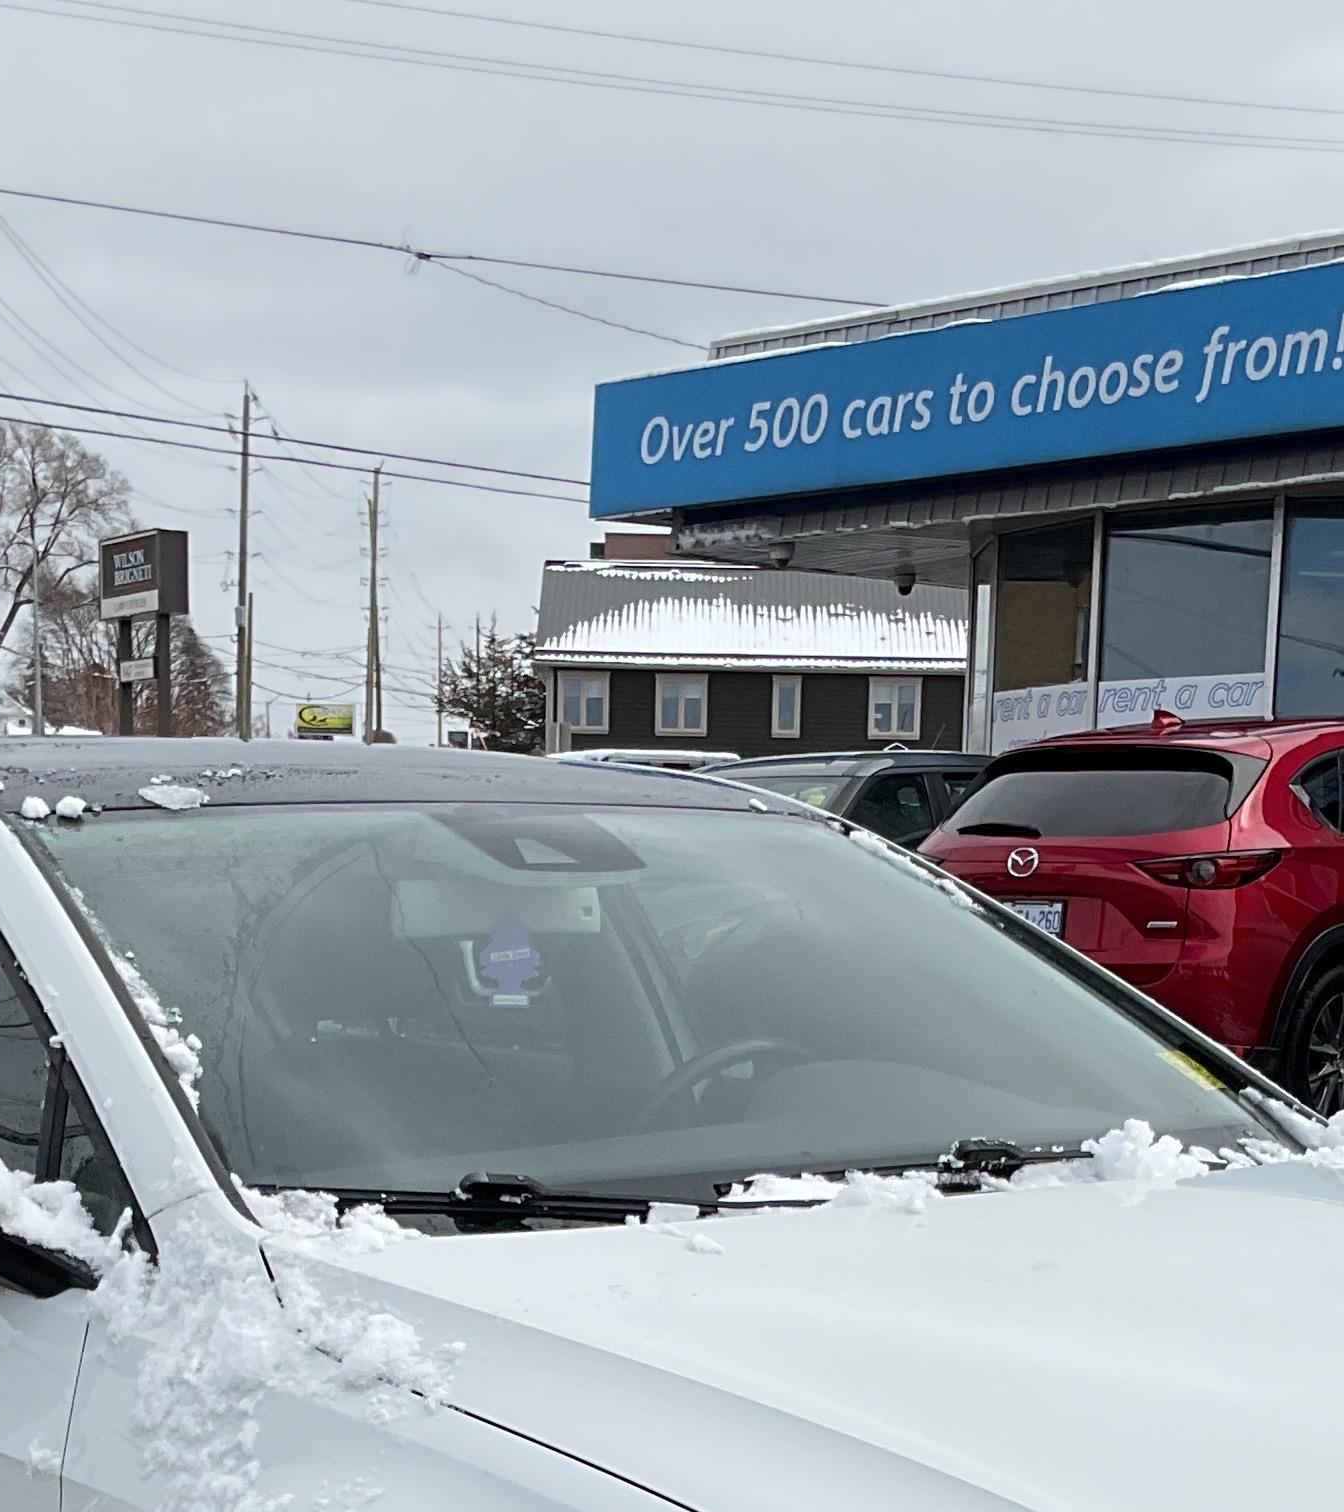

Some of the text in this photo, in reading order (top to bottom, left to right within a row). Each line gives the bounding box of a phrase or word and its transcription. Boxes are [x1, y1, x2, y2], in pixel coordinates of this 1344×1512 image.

[640, 415, 735, 466] Over
[743, 393, 829, 453] 500
[842, 389, 934, 440] cars
[947, 372, 996, 426] to
[1010, 348, 1184, 417] choose
[113, 550, 144, 568] WILSON
[993, 687, 1088, 723] rent a car
[1099, 678, 1266, 714] rent a car
